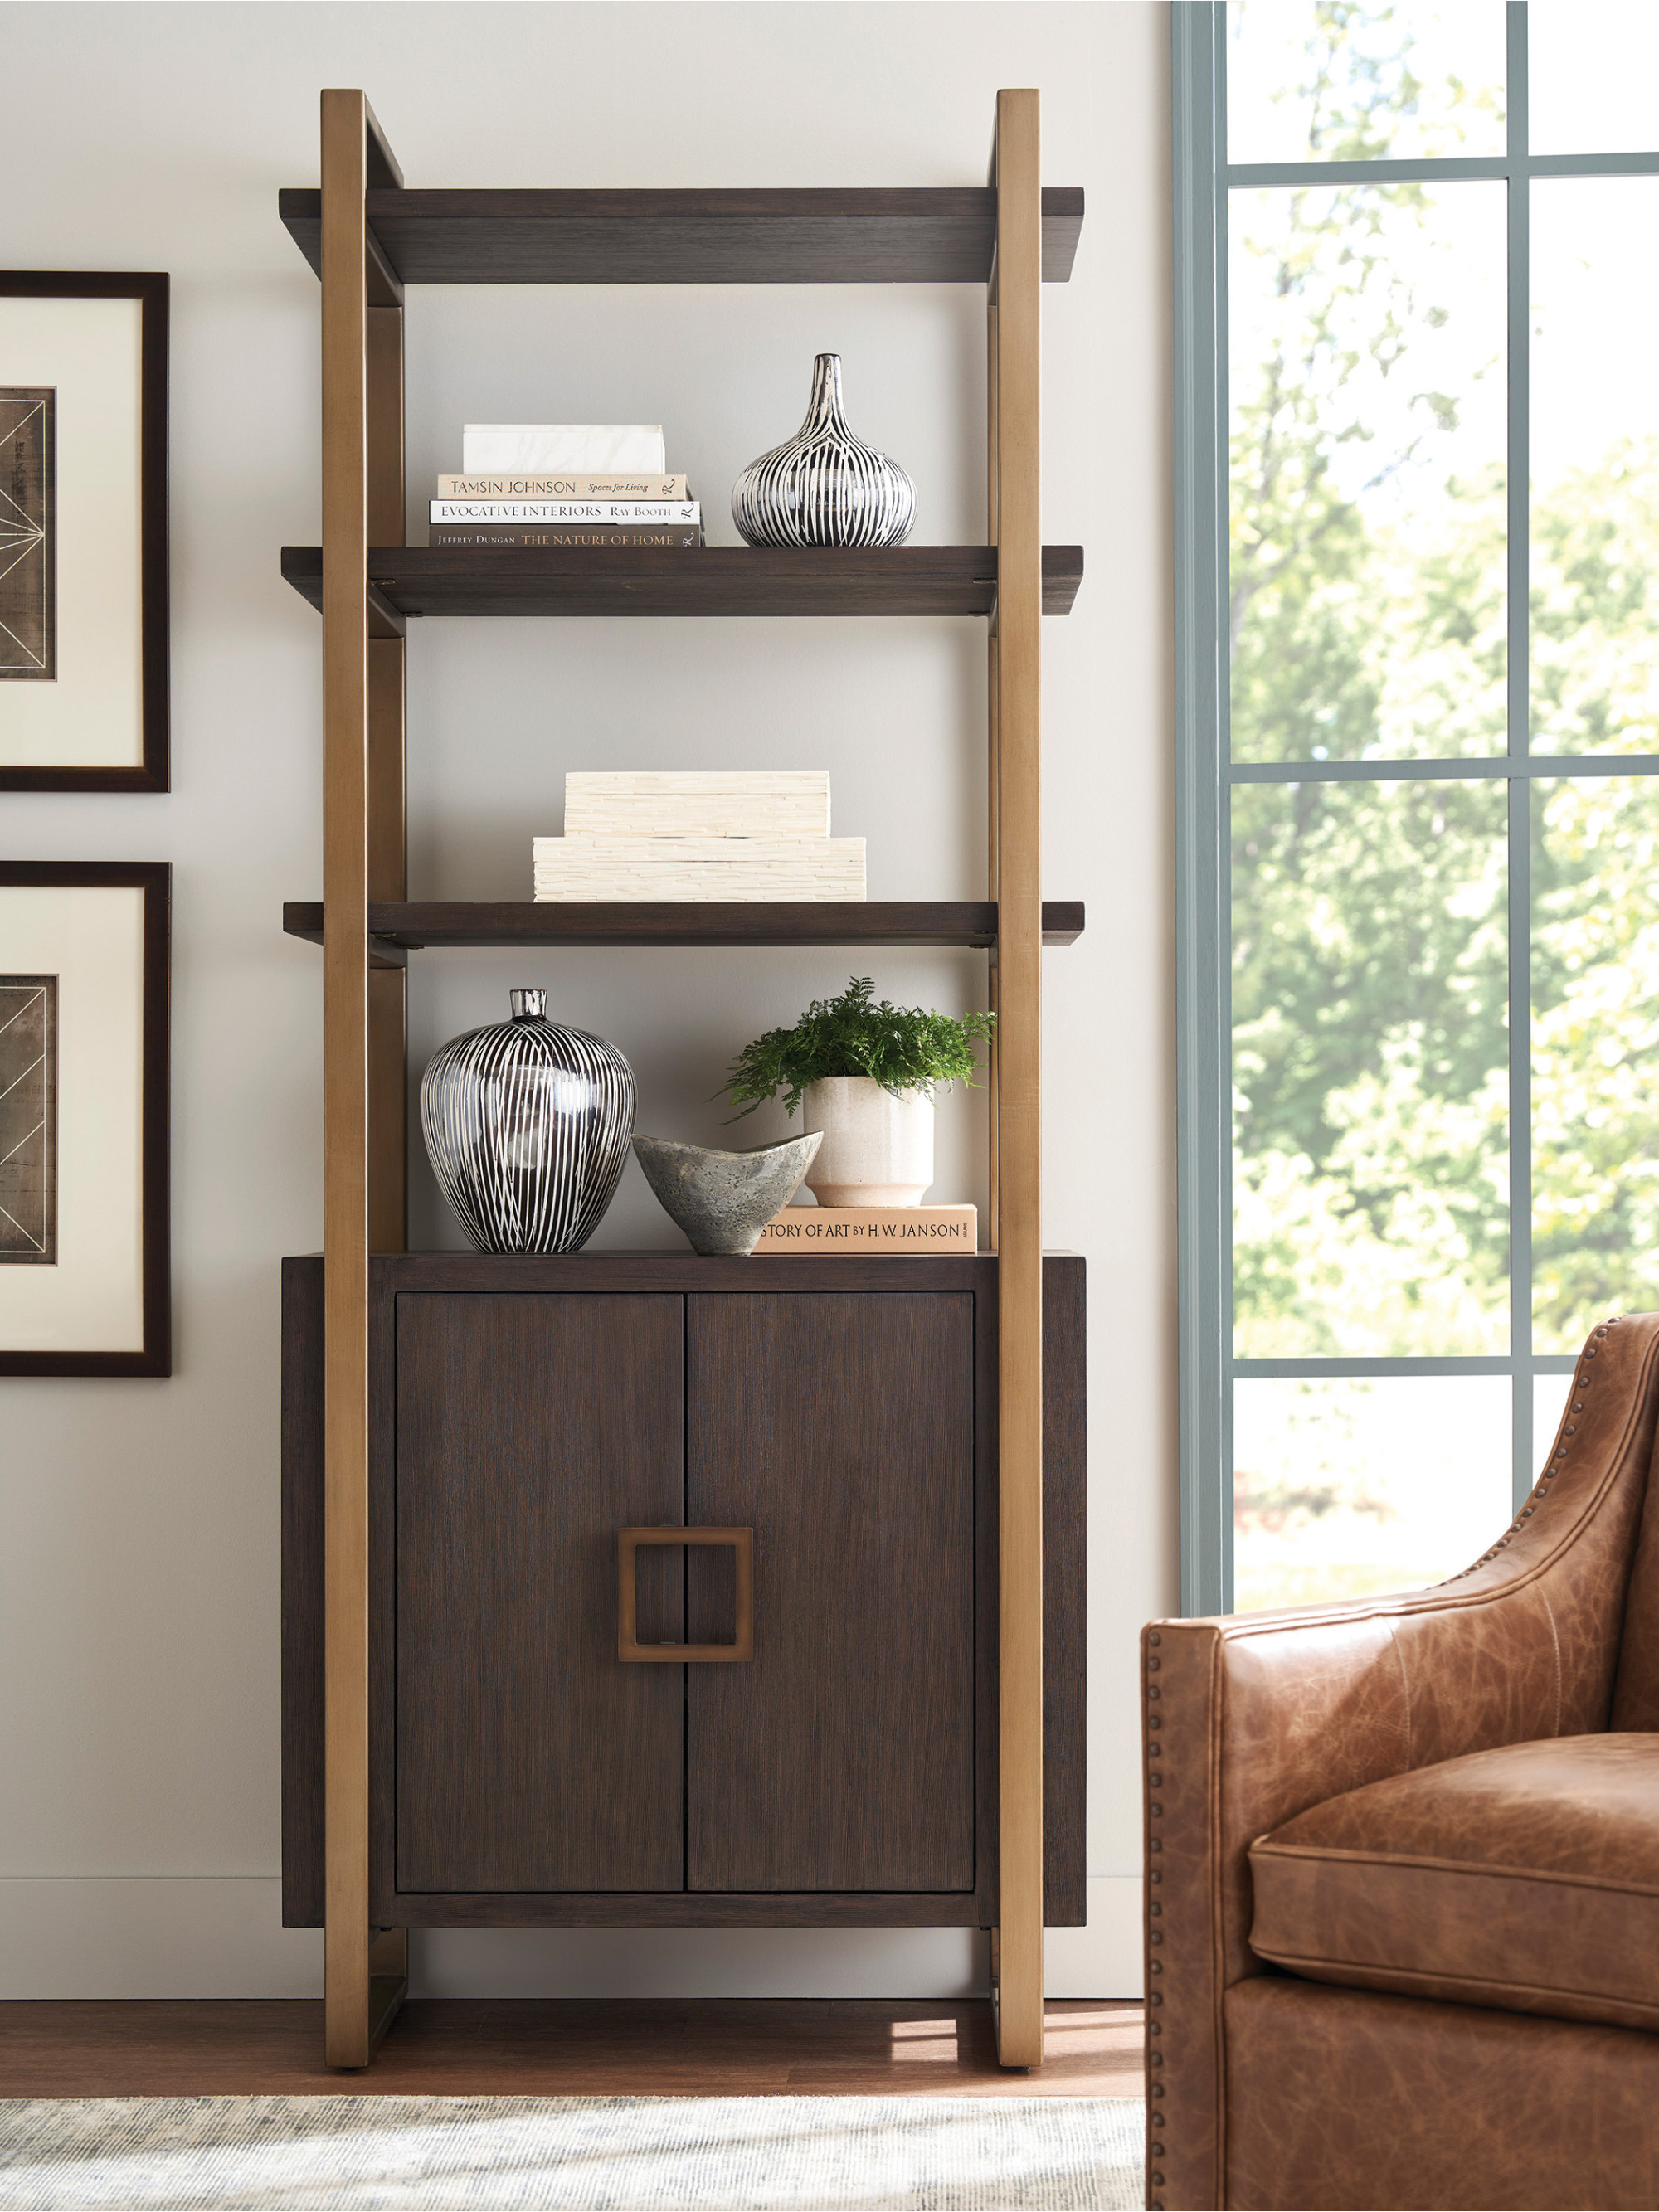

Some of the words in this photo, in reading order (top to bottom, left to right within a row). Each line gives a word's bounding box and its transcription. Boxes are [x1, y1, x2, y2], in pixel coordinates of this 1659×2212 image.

[451, 481, 503, 493] TAMSIN
[508, 481, 576, 493] JOHNSON
[588, 483, 612, 493] Spaces
[612, 483, 624, 493] for
[625, 483, 649, 493] Living
[441, 506, 519, 516] EVOCATIVE
[523, 506, 601, 516] INTERIORS
[522, 535, 550, 545] THE
[553, 535, 608, 545] NATURE
[611, 535, 630, 545] OF
[632, 535, 674, 545] HOME
[805, 1224, 823, 1237] OF
[825, 1224, 850, 1237] ART
[853, 1225, 865, 1236] BY
[868, 1224, 879, 1237] H.
[882, 1224, 897, 1237] W.
[899, 1223, 960, 1238] JANSON
